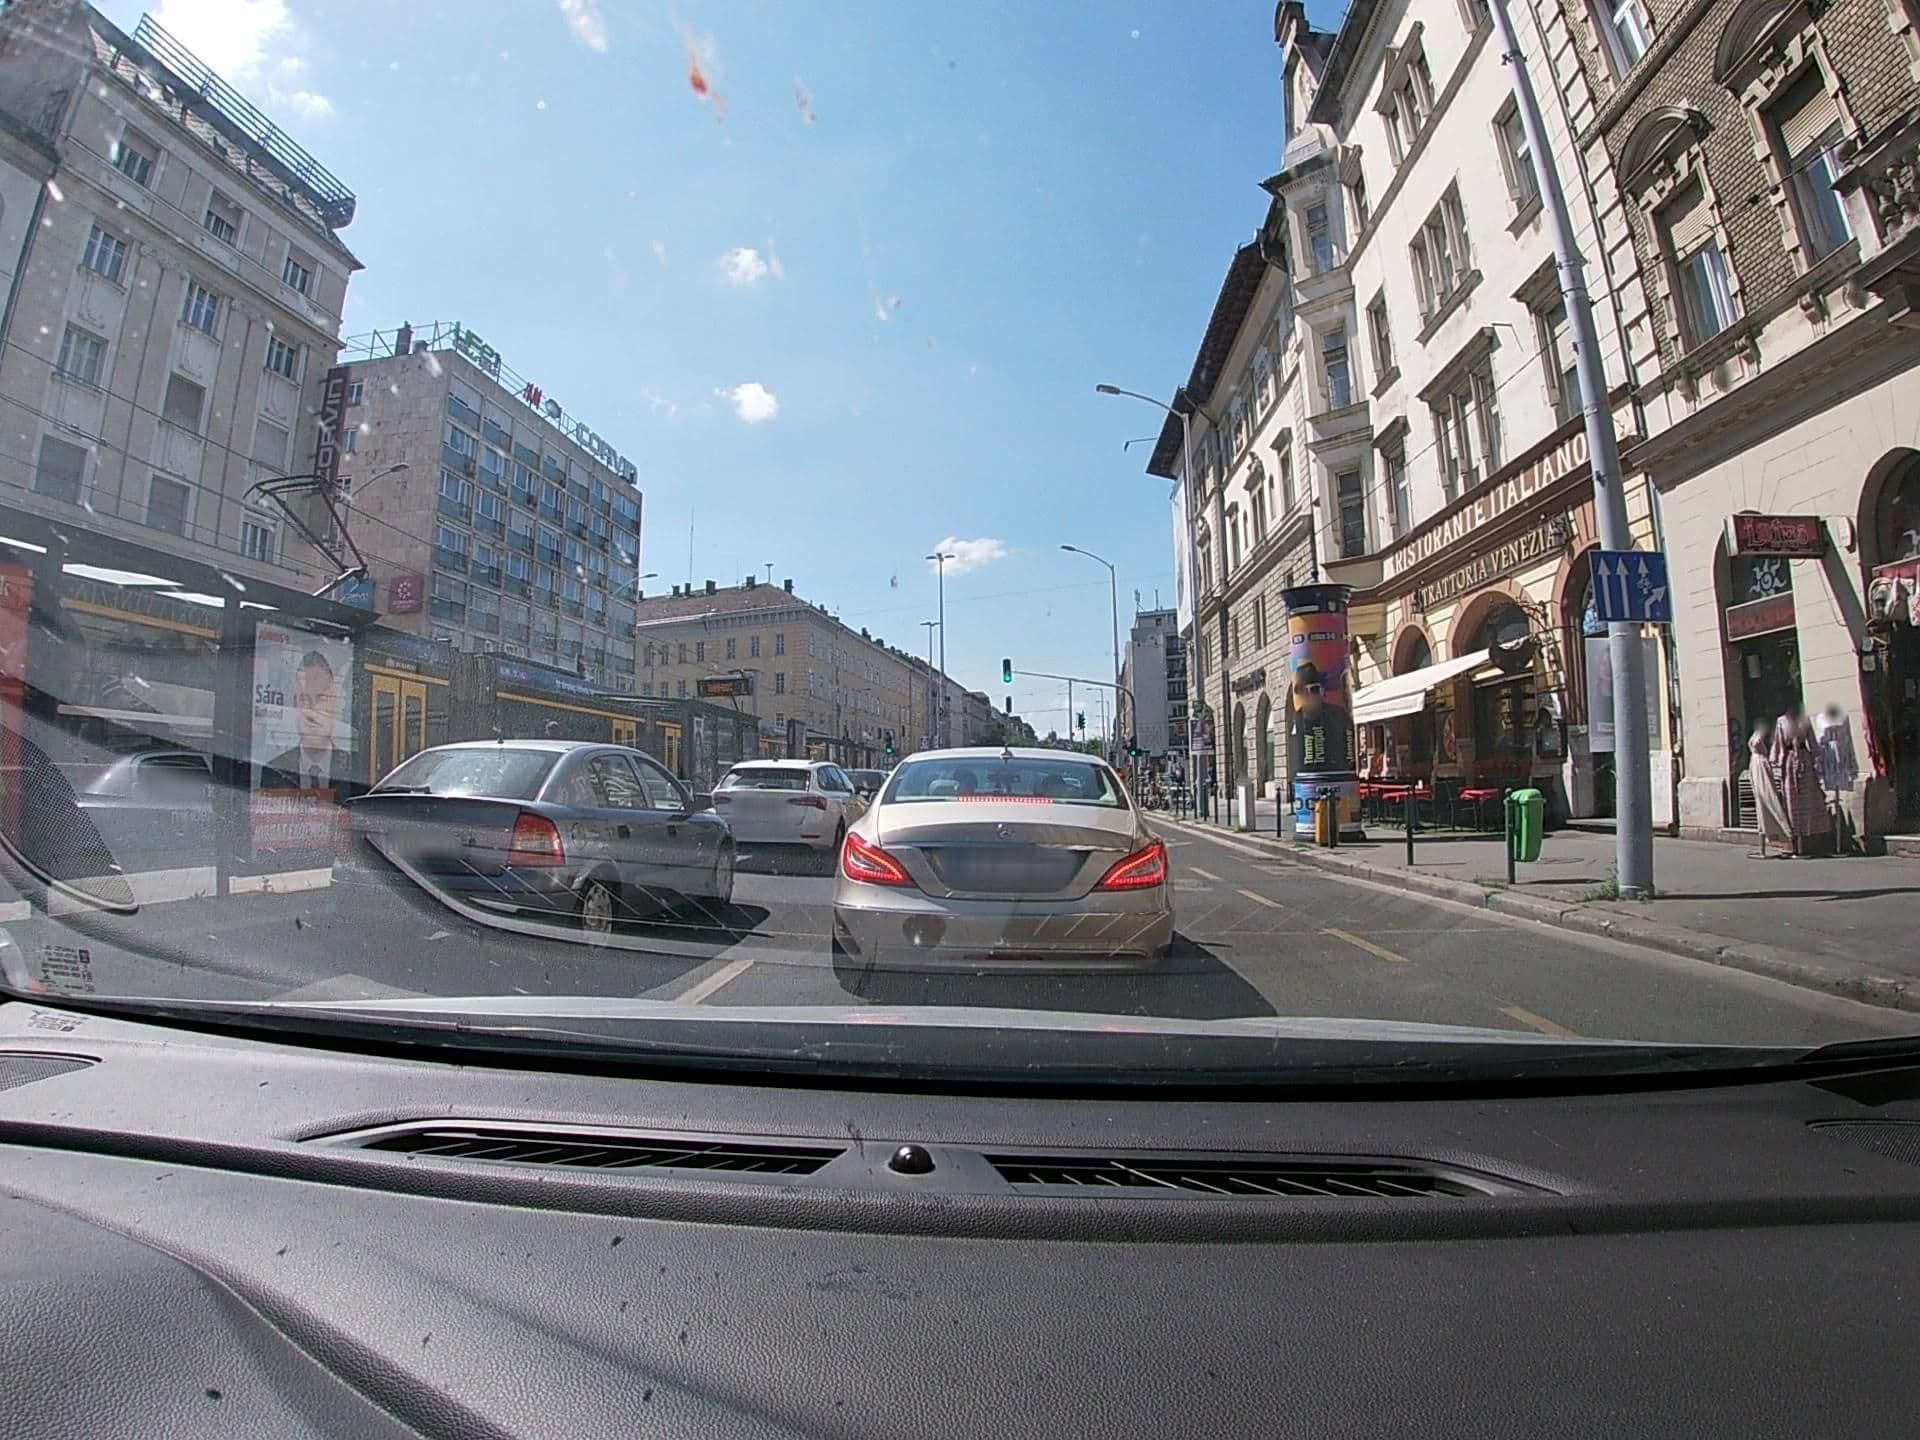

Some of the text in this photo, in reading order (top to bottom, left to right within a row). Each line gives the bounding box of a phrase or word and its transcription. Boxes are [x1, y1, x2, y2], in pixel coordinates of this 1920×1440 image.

[1393, 432, 1589, 574] RISTORANTE ITALIANO
[1420, 521, 1560, 609] TRATTORIA VENEZIA
[255, 684, 284, 706] Sára
